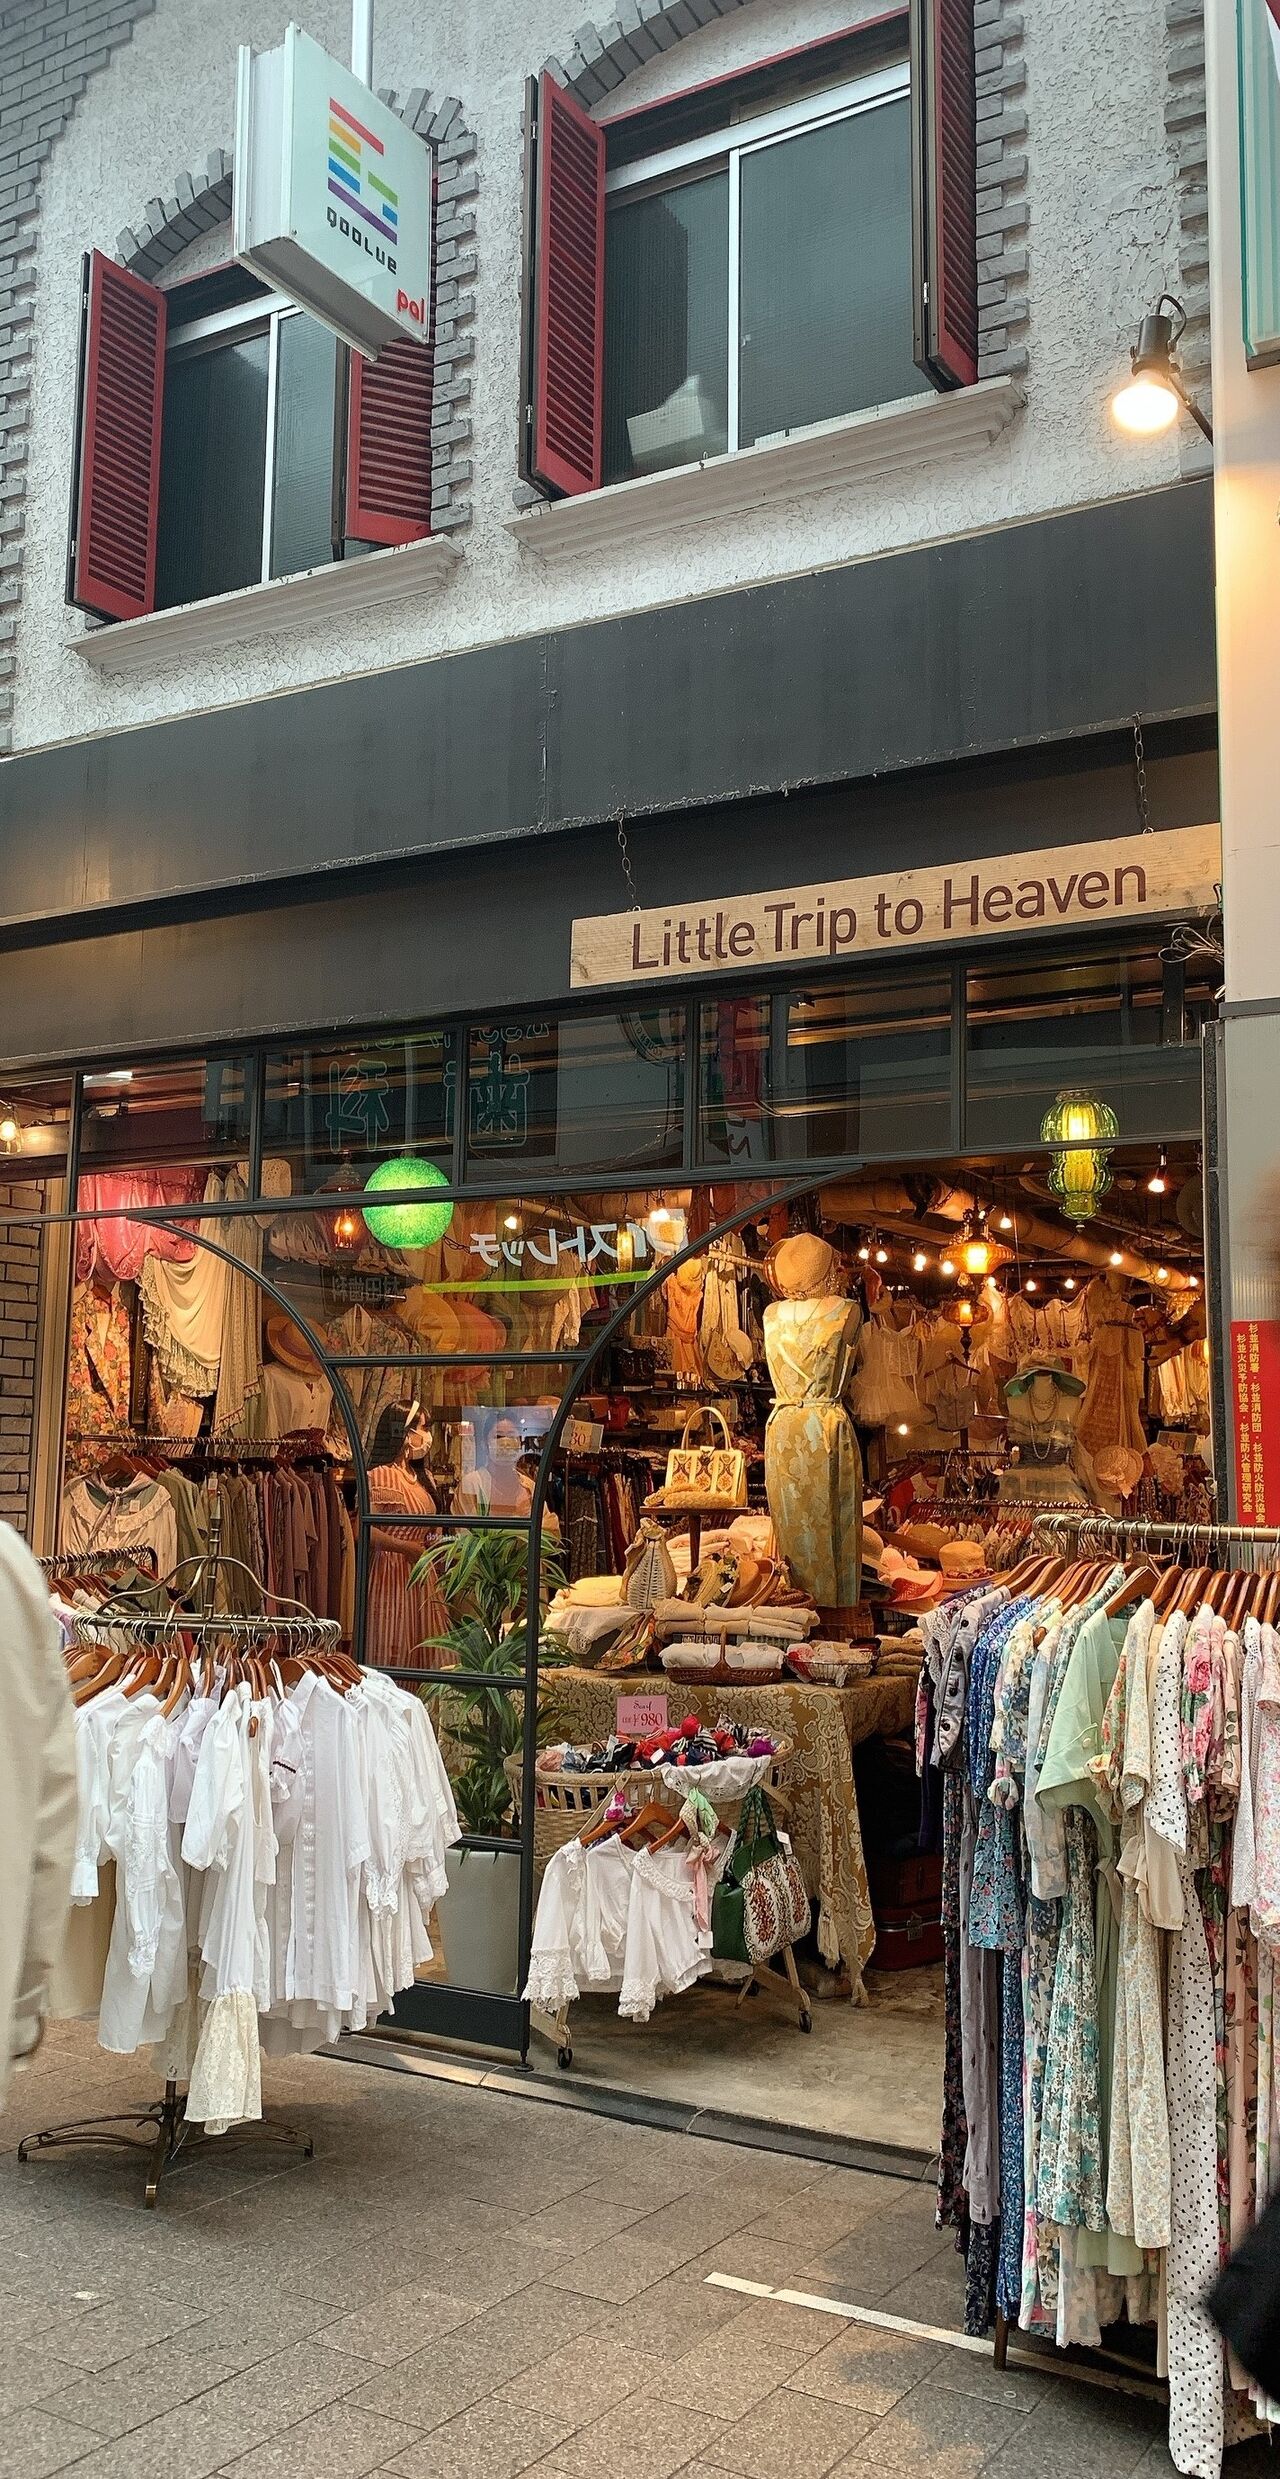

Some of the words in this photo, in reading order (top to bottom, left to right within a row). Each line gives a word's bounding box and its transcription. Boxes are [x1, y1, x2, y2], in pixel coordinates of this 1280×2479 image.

[397, 288, 425, 324] pal
[631, 911, 756, 970] Little
[764, 896, 858, 955] Trip
[874, 891, 924, 938] to
[943, 865, 1147, 930] Heaven
